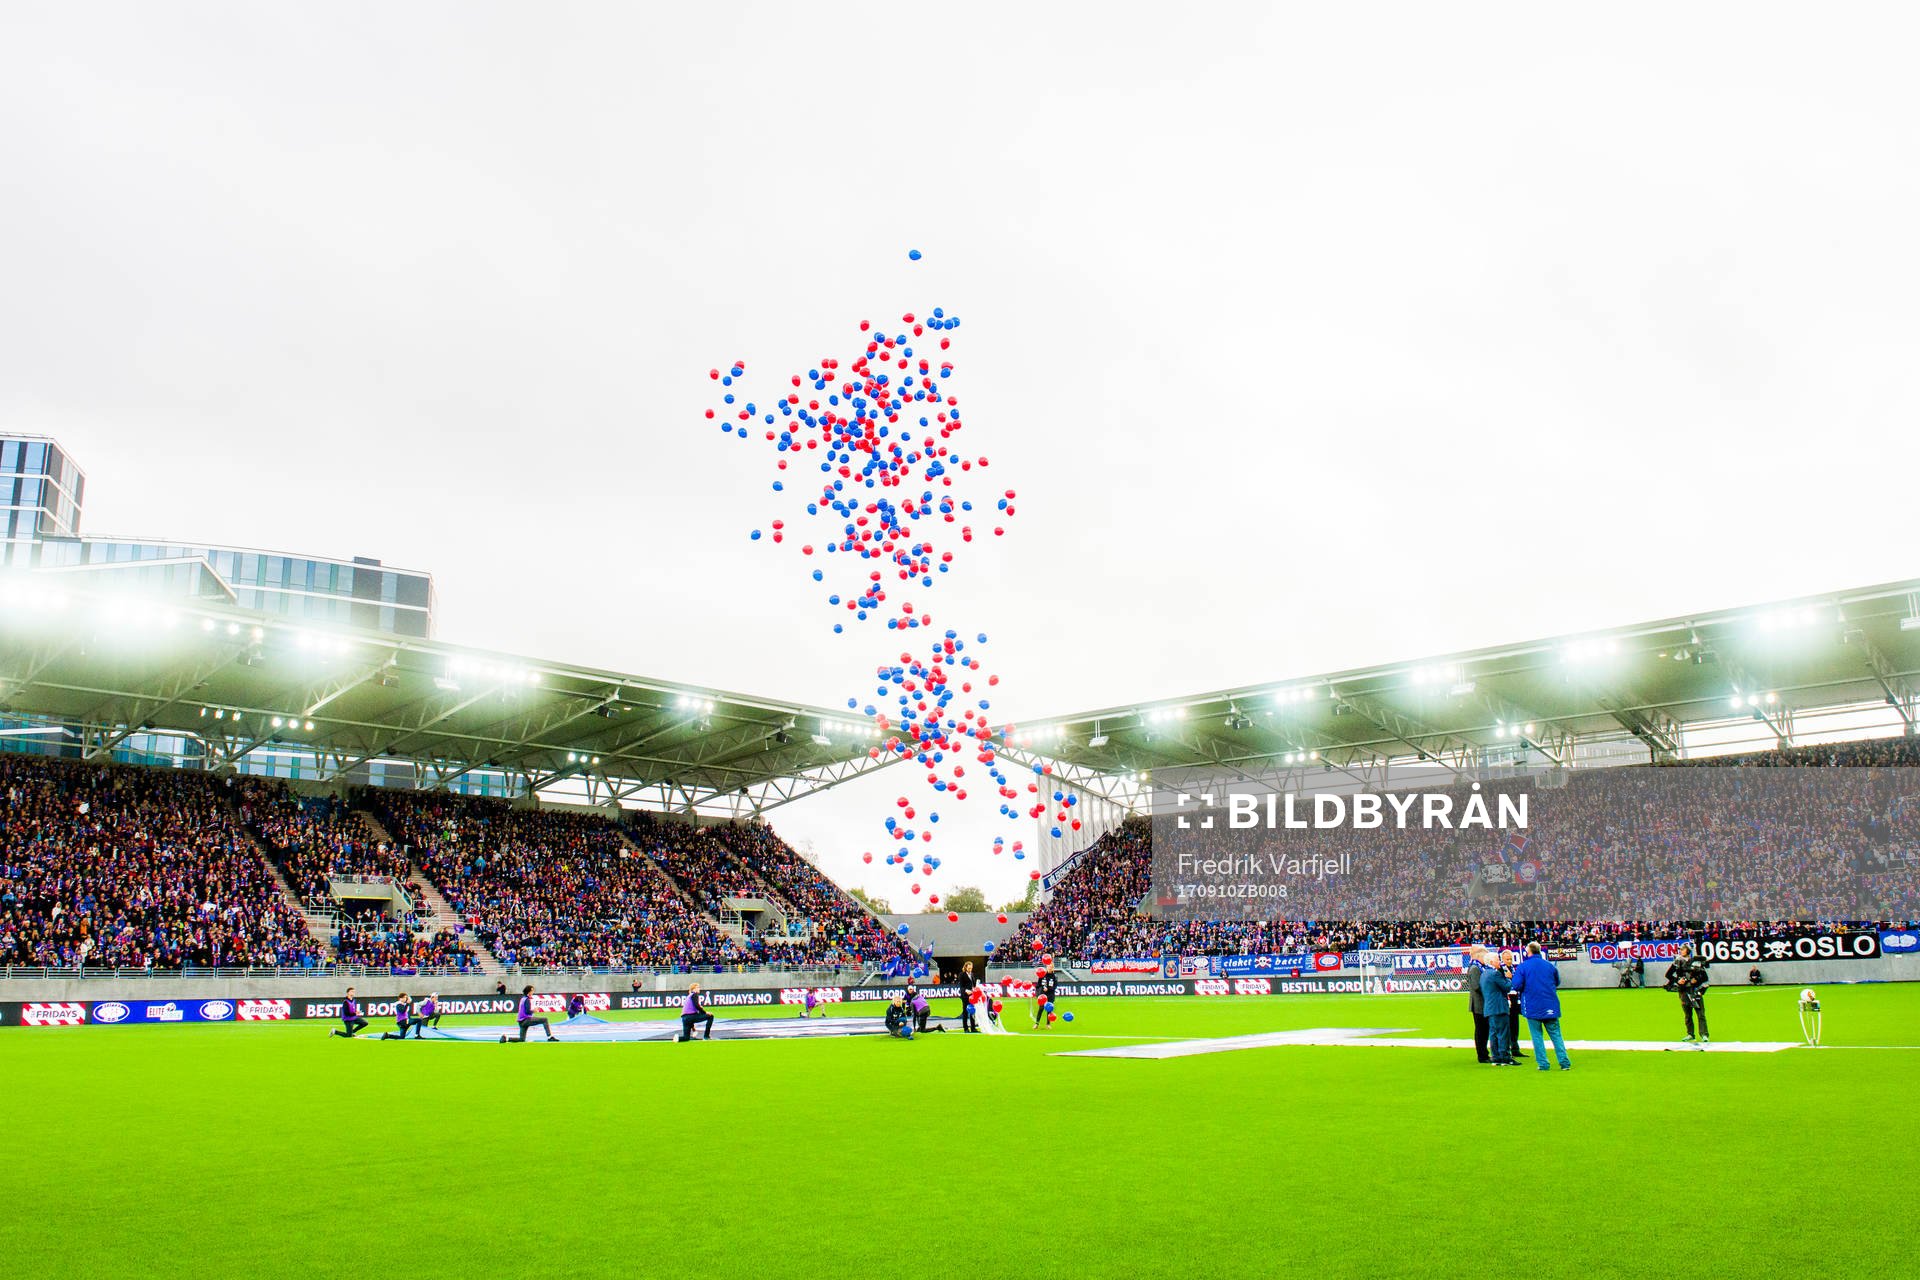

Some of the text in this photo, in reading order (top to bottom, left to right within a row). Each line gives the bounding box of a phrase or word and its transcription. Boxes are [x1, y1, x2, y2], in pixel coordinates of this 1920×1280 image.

[1591, 942, 1690, 960] BOHEMEN
[1701, 935, 1876, 961] 0658 OSLO
[1054, 981, 1185, 996] STILL BORD PÅ FRIDAYS.NO
[1281, 981, 1326, 993] BESTILL
[1328, 981, 1361, 992] BORD
[621, 991, 772, 1008] BESTILL BOR PÅ FRIDAYS.NO
[850, 990, 882, 1000] BESTILL
[883, 989, 905, 999] BORD
[35, 1010, 78, 1019] FRIDAYS
[149, 1007, 164, 1016] ELITE
[249, 1006, 284, 1014] FRIDAYS
[306, 1003, 364, 1018] BESTL
[367, 1002, 409, 1016] BOR
